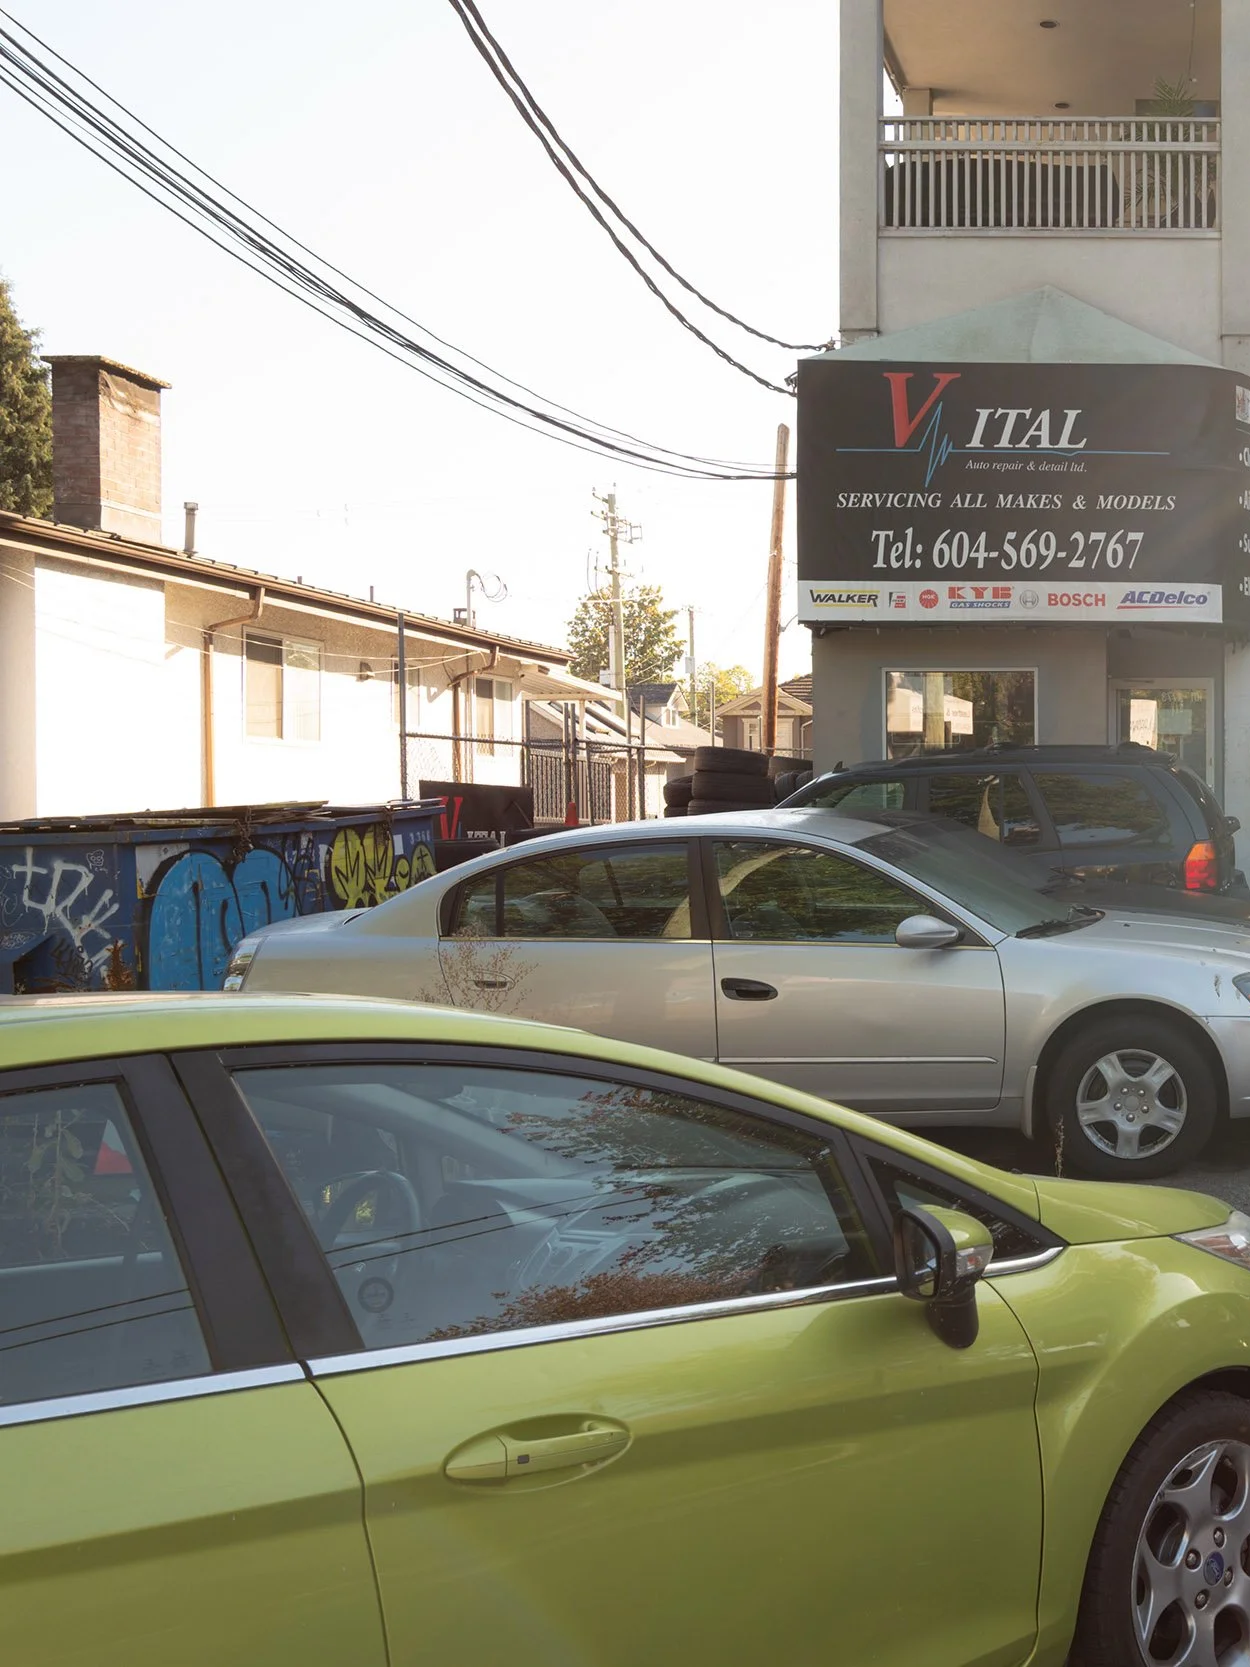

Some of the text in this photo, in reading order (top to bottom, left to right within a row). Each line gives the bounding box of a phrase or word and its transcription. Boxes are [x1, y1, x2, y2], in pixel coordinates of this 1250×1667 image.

[965, 460, 1087, 473] Auto repair & detail ltd.
[837, 492, 1176, 511] SERVICING ALL MAKES & MODELS
[871, 529, 1144, 570] Tel: 604-569-2767
[809, 589, 878, 608] WALKER
[948, 586, 1012, 600] KYB
[1047, 593, 1106, 607] BOSCH
[1120, 591, 1208, 605] ACDelco
